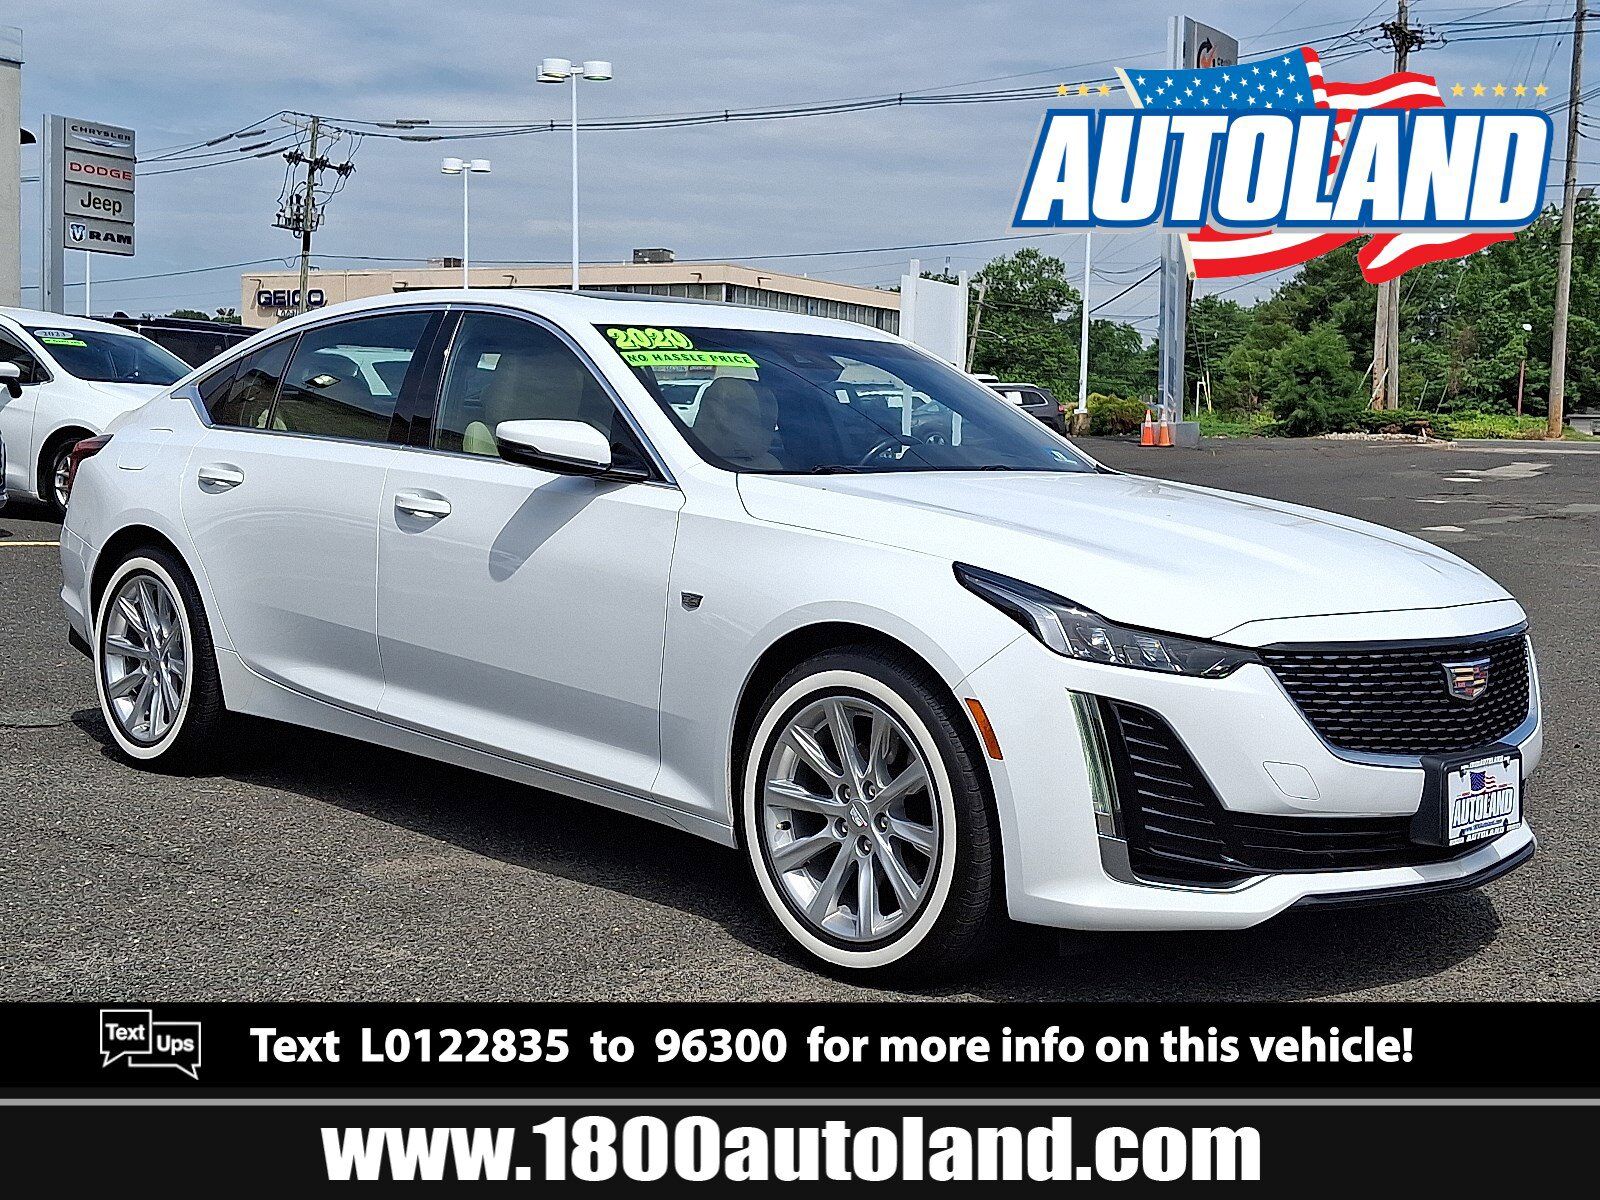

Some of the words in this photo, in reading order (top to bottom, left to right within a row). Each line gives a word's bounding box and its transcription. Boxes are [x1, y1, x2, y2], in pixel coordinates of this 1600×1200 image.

[70, 124, 132, 141] CHRYSLER
[69, 162, 133, 181] DODGE
[80, 191, 122, 216] Jeep
[88, 230, 132, 245] RAM
[256, 289, 325, 307] GEICO
[606, 327, 694, 350] 2020
[626, 353, 649, 363] NO
[652, 353, 706, 363] HASSLE
[710, 354, 753, 365] PRICE
[1452, 787, 1514, 829] AUTOLAND
[1466, 826, 1505, 842] AUTOLAND
